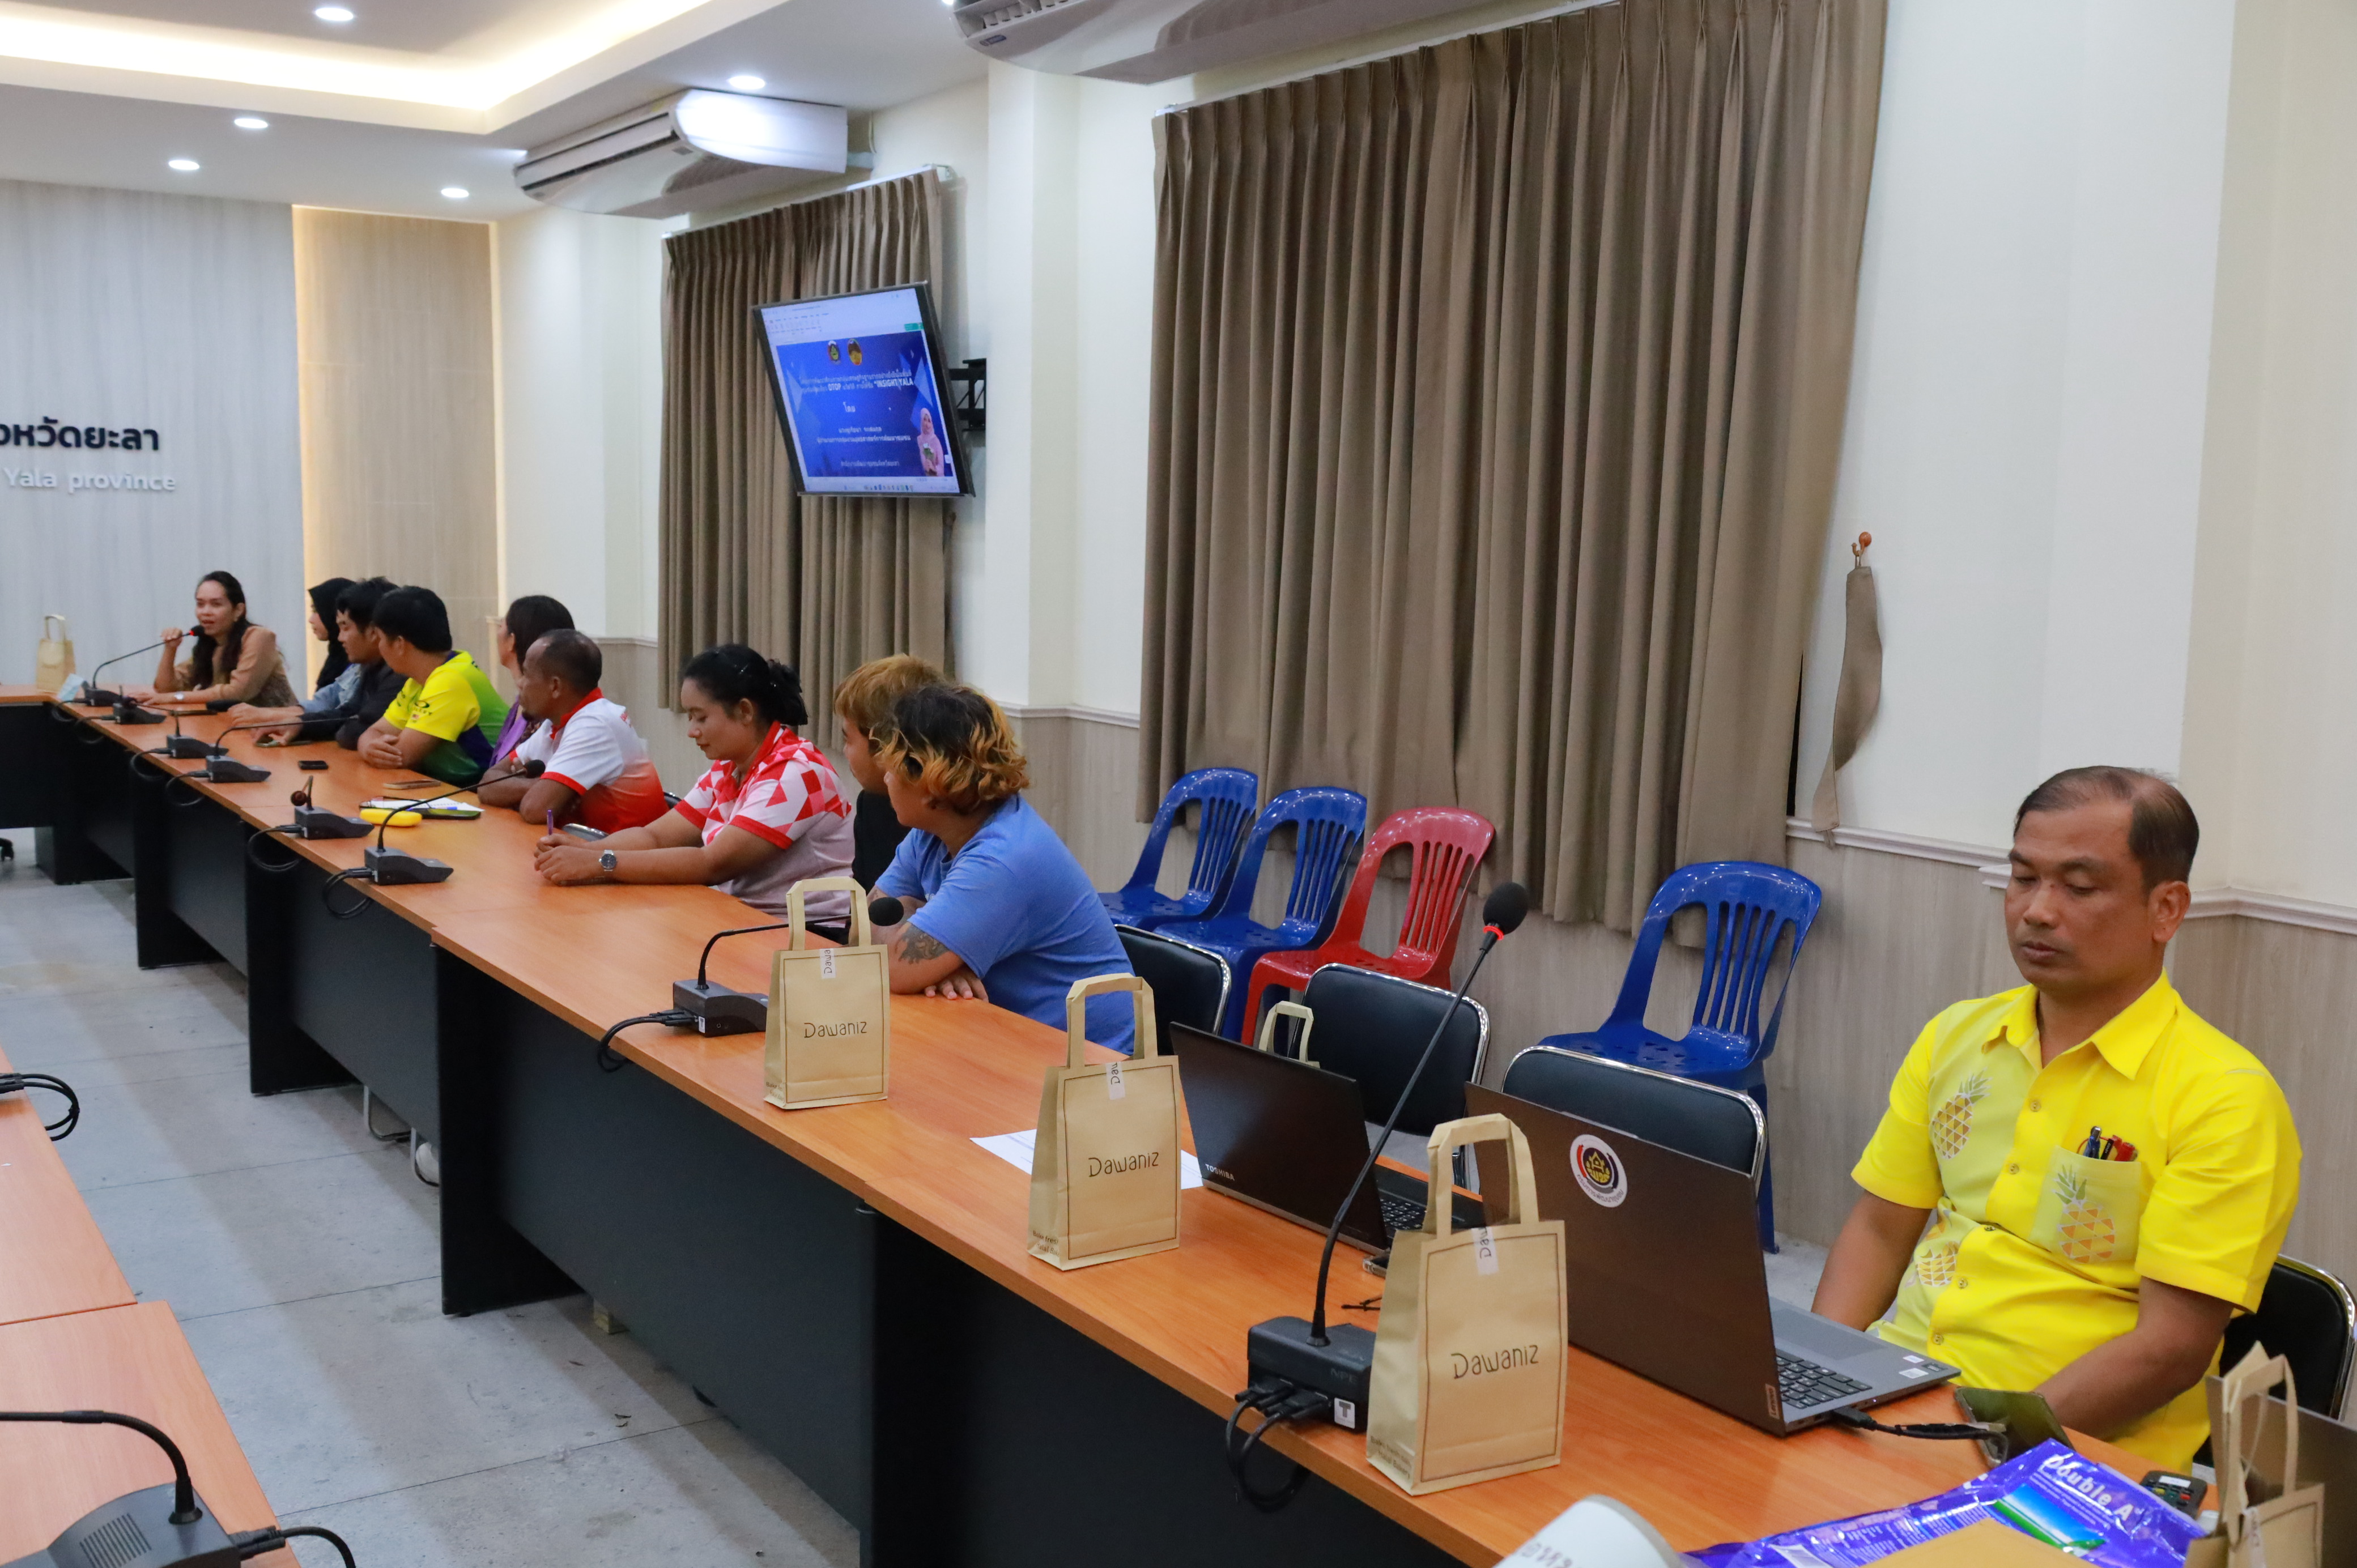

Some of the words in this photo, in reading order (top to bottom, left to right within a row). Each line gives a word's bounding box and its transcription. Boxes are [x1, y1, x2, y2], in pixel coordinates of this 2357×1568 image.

[828, 383, 841, 391] OTOP
[899, 377, 914, 386] YALA
[3, 467, 57, 488] Yala
[68, 472, 176, 495] province
[804, 1022, 867, 1038] Dawaniz
[1088, 1152, 1159, 1178] Dawaniz
[1205, 1163, 1235, 1182] TOSHIBA
[1450, 1345, 1539, 1379] Dawaniz
[2042, 1453, 2112, 1506] Double
[2113, 1503, 2134, 1522] A
